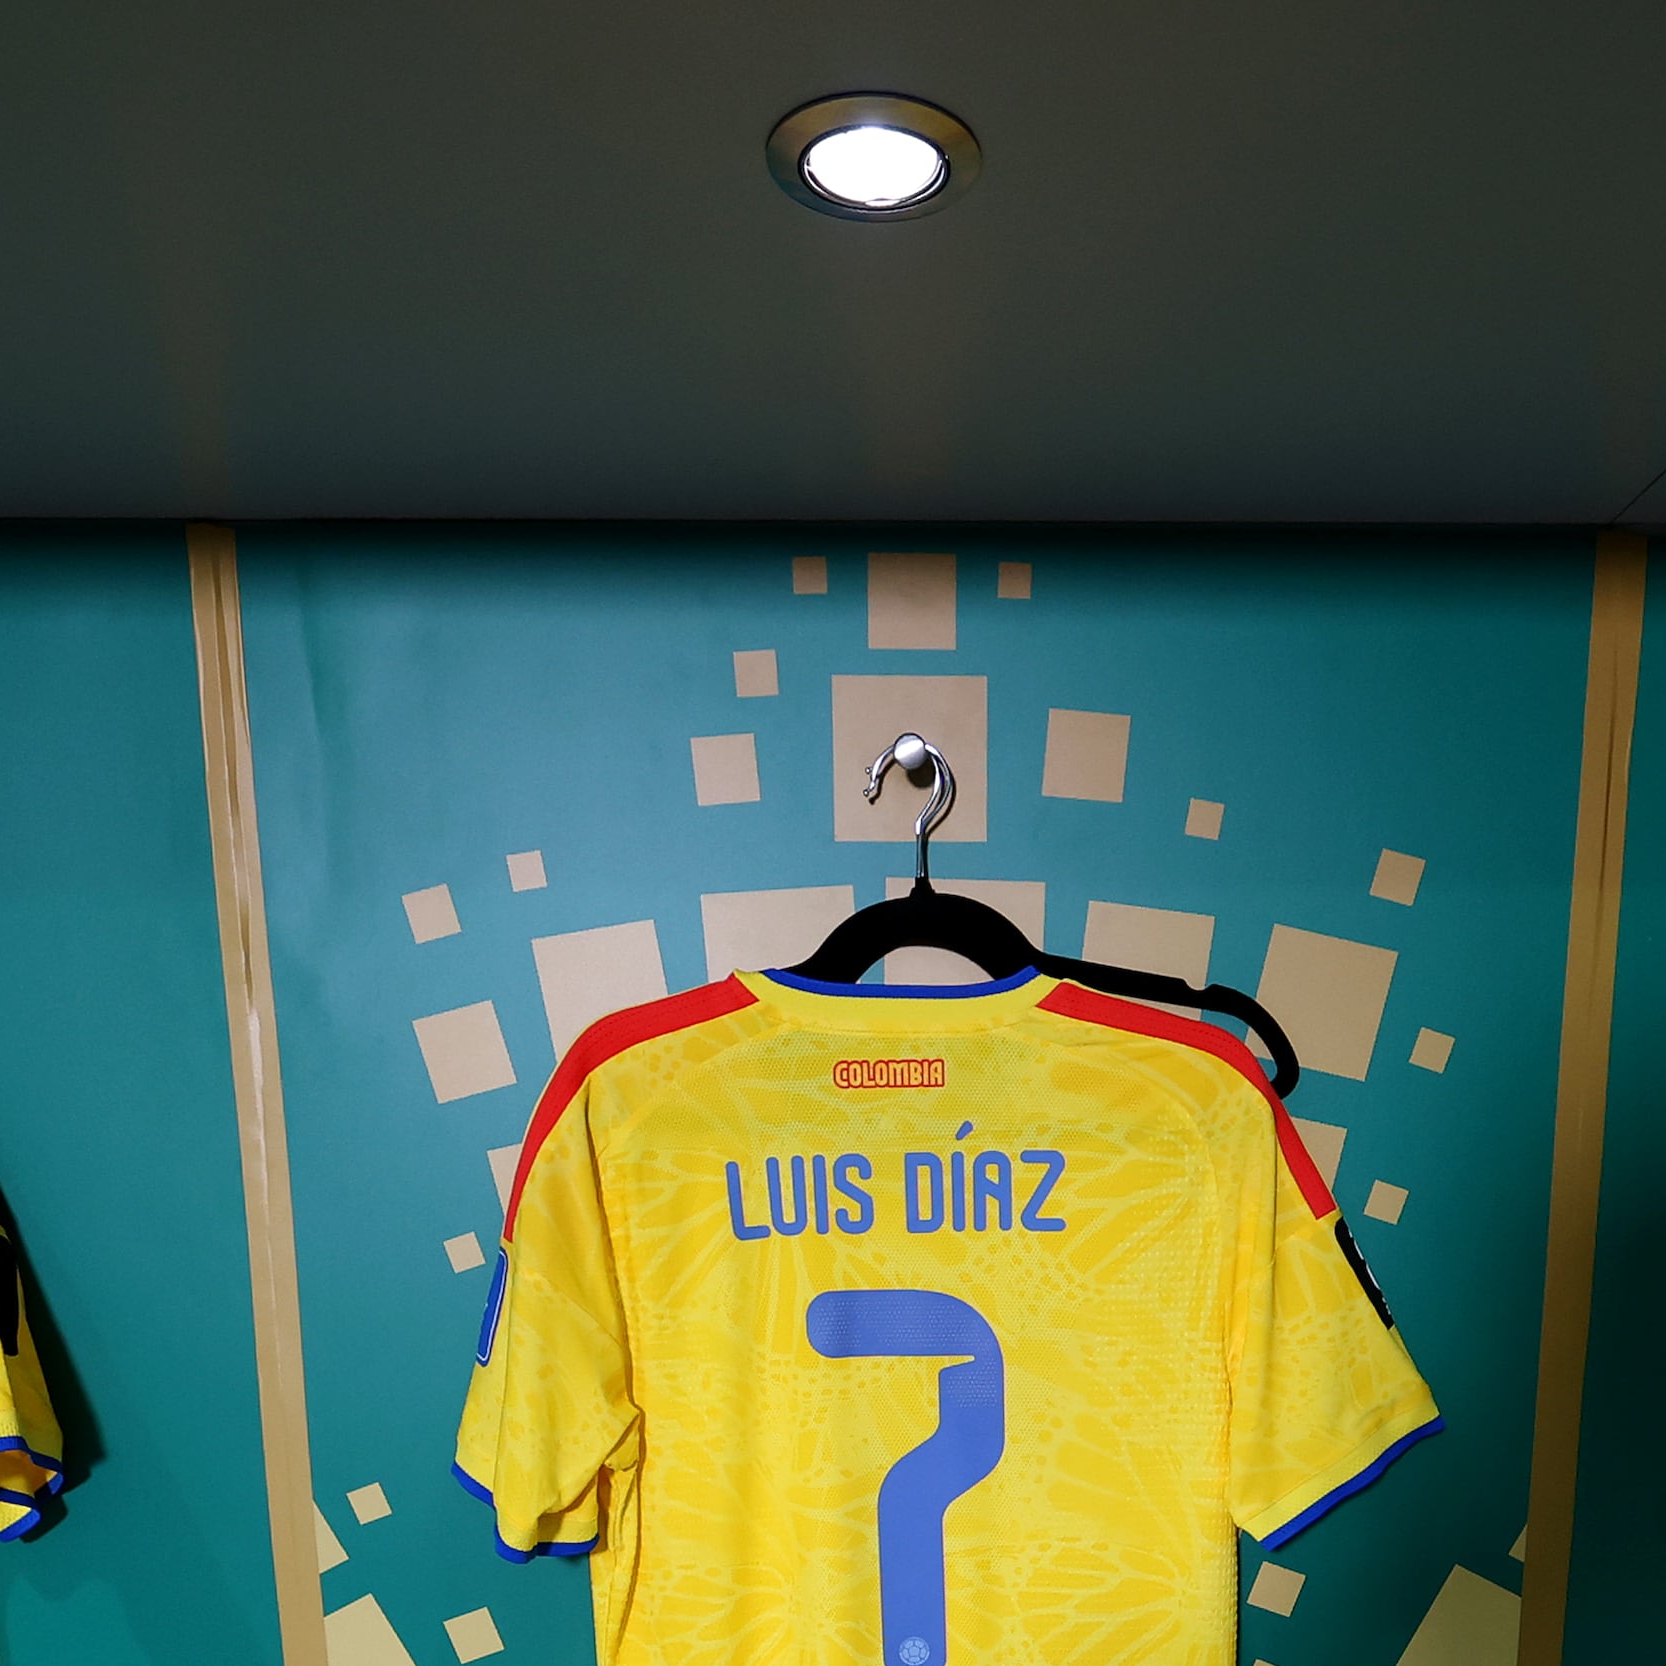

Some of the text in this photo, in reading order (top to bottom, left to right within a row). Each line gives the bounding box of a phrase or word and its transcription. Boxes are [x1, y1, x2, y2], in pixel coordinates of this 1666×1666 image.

[833, 1058, 945, 1089] COLOMBIA
[726, 1121, 1066, 1241] LUIS DÍAZ
